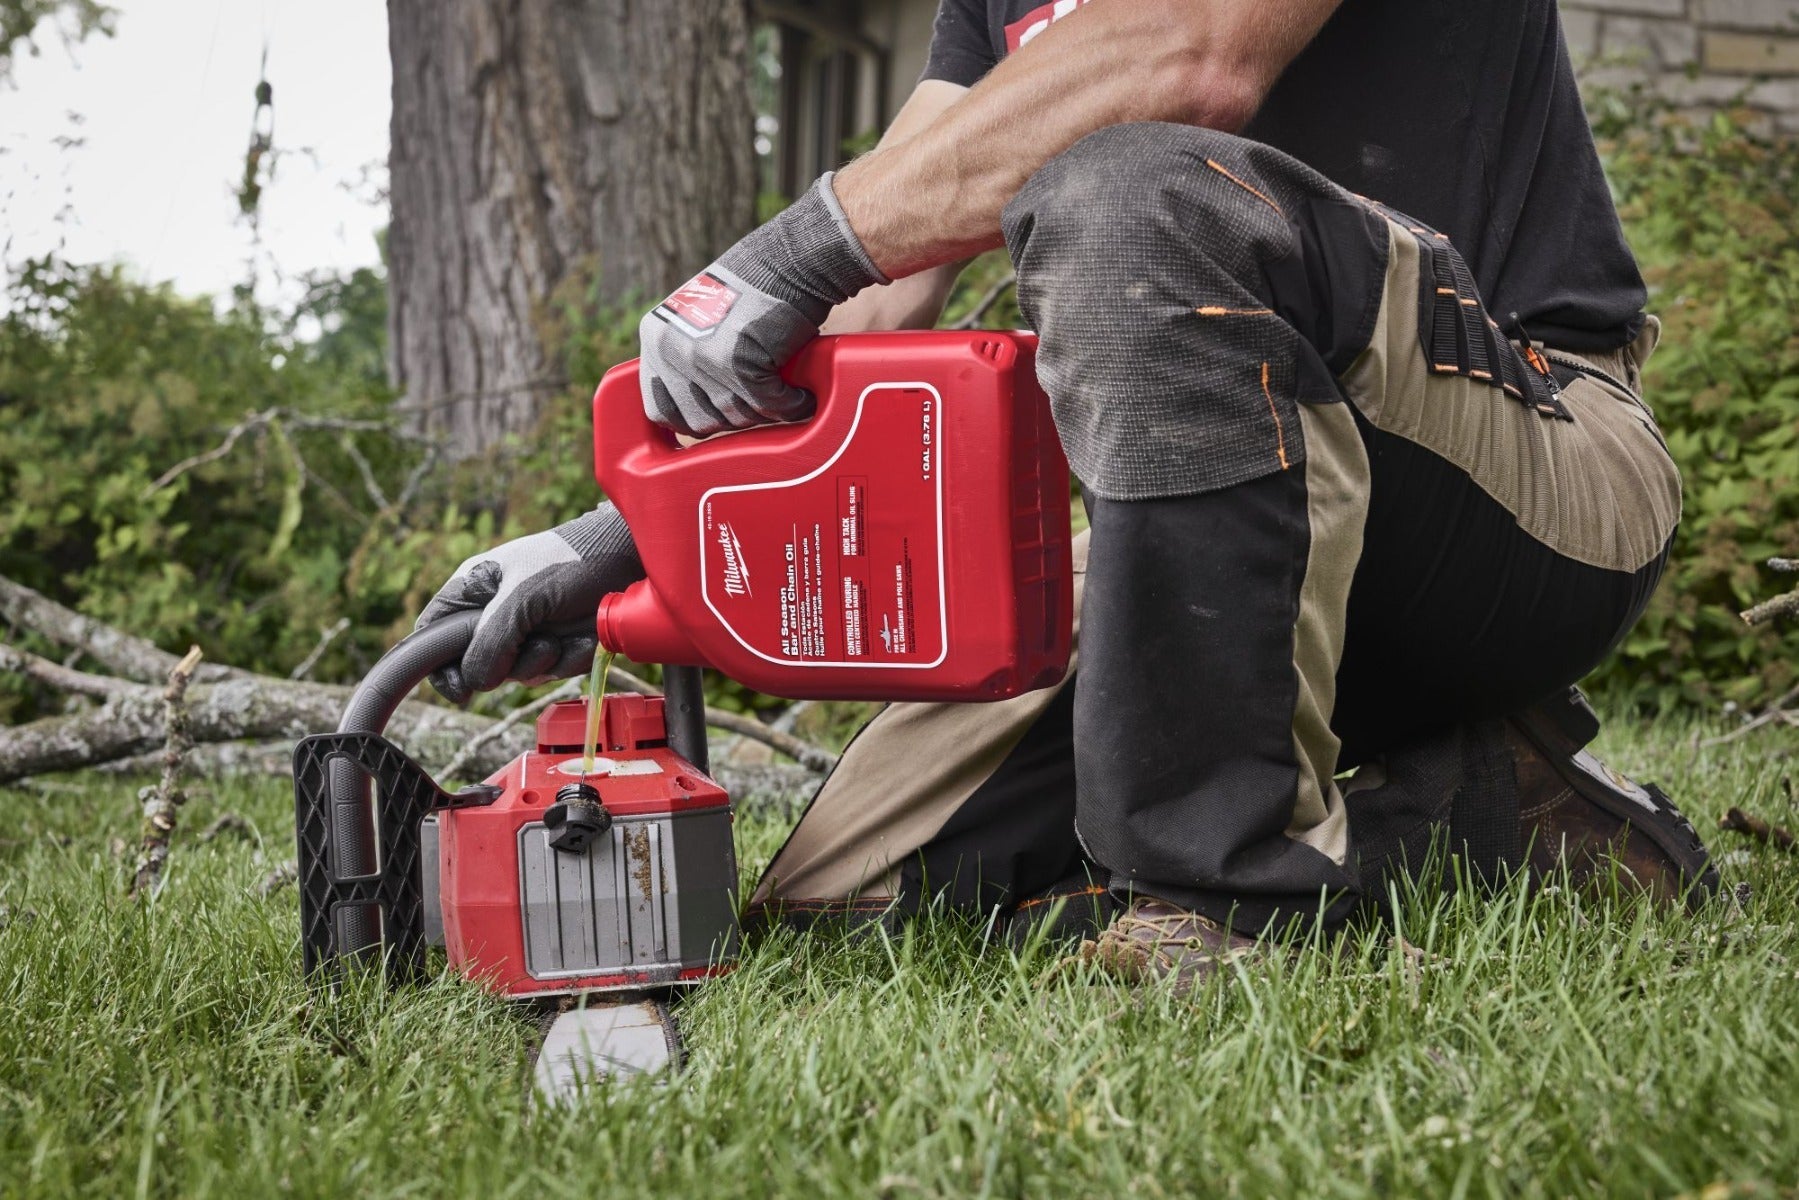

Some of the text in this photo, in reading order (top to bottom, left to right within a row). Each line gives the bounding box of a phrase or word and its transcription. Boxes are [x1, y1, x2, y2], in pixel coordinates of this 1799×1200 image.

[923, 401, 931, 411] L)
[923, 415, 931, 445] (3.78
[718, 522, 745, 598] Milwaukee
[785, 544, 794, 561] Oil
[787, 565, 795, 601] Chain
[780, 588, 790, 655] All Season
[788, 605, 796, 629] and
[806, 619, 811, 629] de
[844, 577, 855, 655] CONTROLLED POURING
[897, 610, 905, 642] CHAINSAWS
